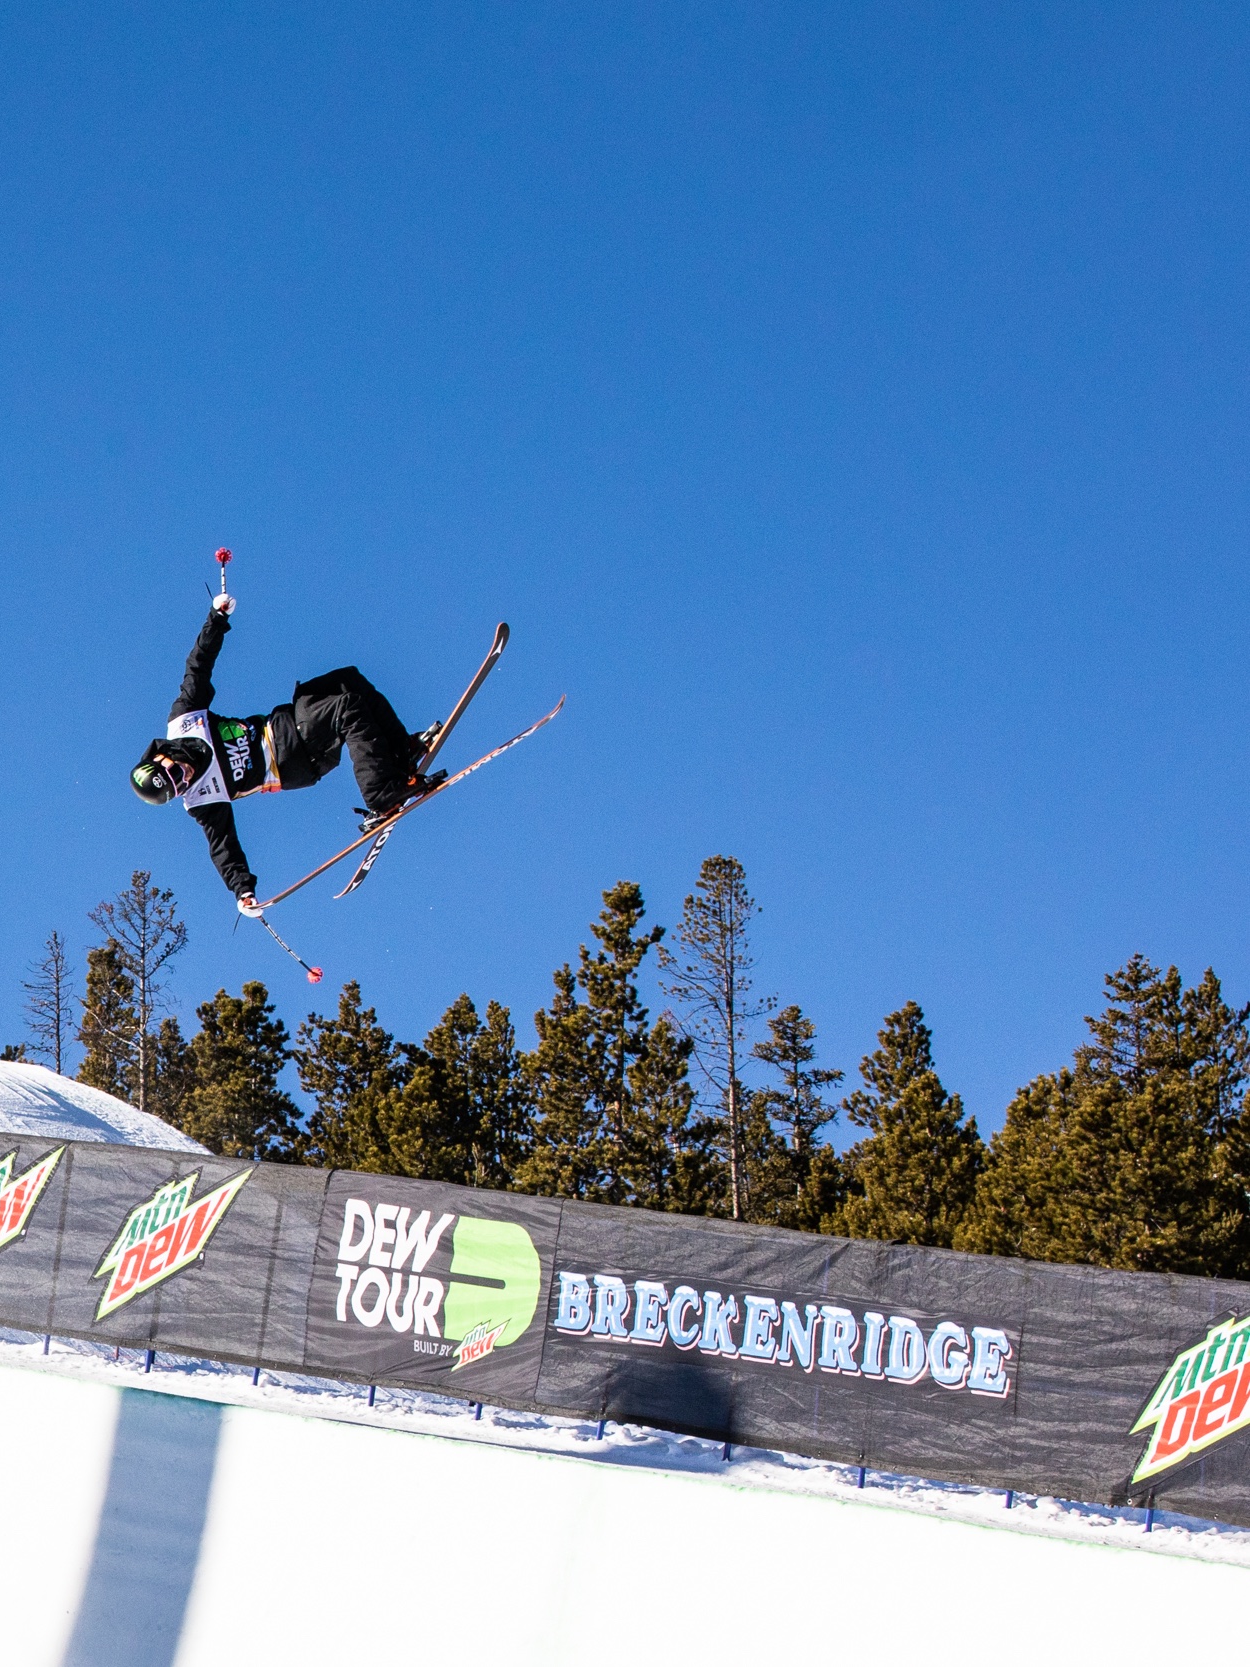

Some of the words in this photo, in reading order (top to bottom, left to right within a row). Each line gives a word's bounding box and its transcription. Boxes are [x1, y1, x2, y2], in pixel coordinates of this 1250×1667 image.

[224, 742, 244, 782] DEW
[337, 1198, 455, 1272] DEW
[335, 1263, 444, 1338] TOUR
[553, 1270, 1012, 1398] BRECKENRIDGE
[413, 1340, 439, 1355] BUILT
[439, 1344, 453, 1357] BY
